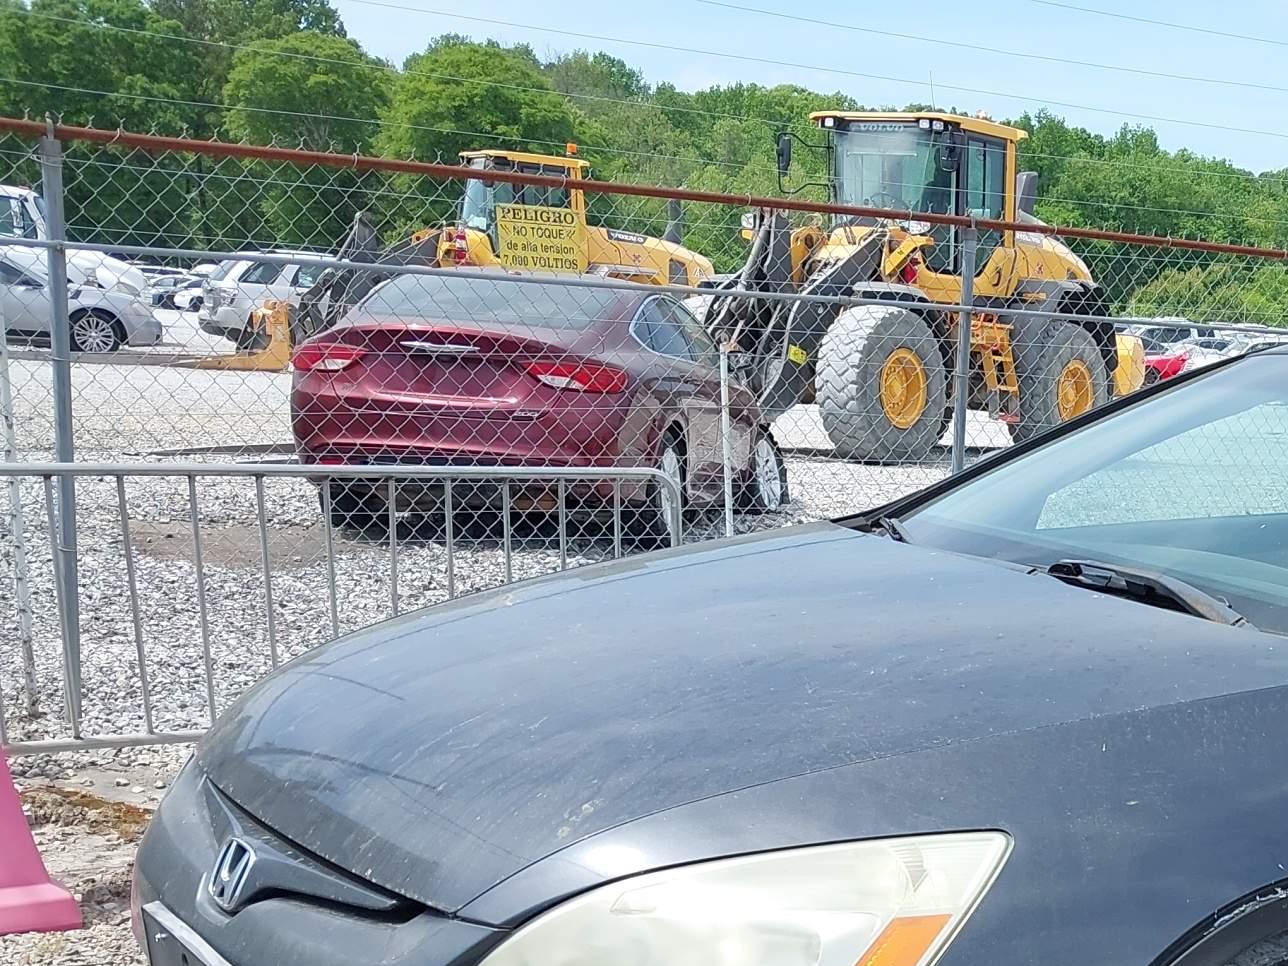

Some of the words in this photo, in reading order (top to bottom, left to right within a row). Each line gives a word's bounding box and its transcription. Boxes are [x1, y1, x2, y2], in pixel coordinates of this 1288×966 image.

[501, 207, 575, 225] PELIGRO
[512, 225, 527, 237] NO
[506, 240, 519, 251] de
[503, 254, 529, 266] 7,000
[530, 256, 579, 270] VOLTIOS
